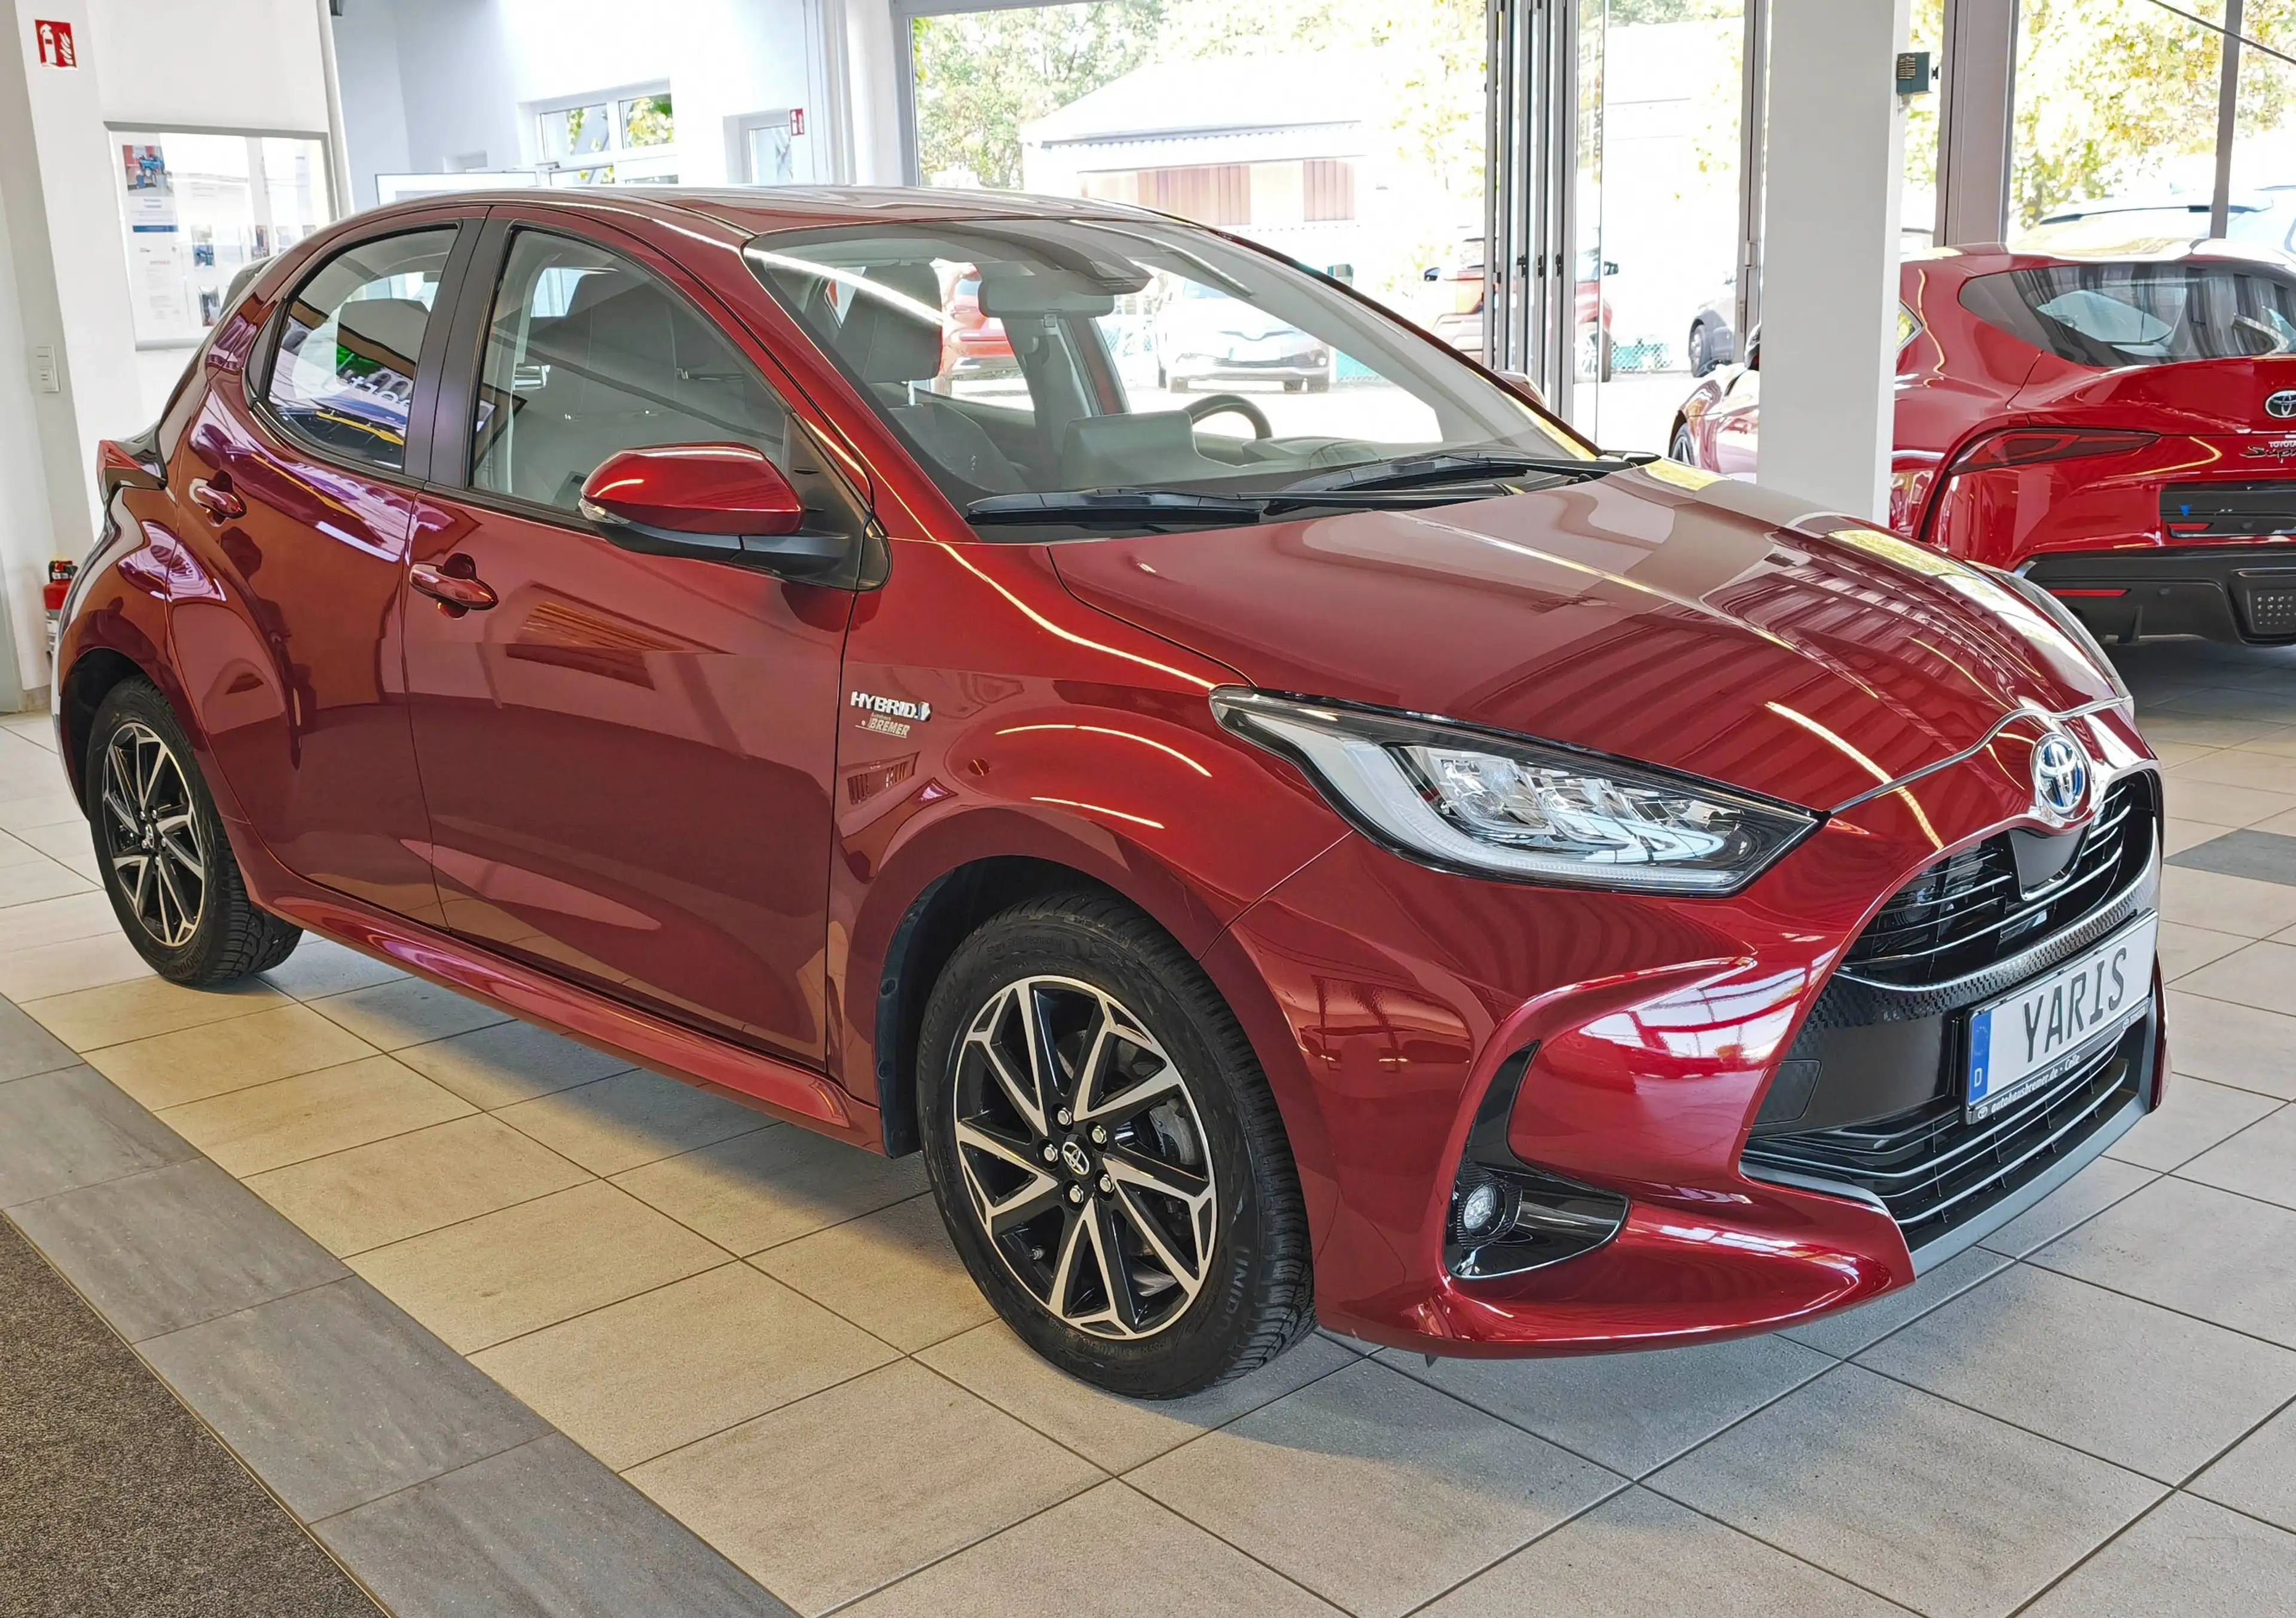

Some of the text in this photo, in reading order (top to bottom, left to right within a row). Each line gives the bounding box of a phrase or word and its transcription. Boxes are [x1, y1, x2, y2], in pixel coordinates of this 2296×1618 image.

[850, 691, 917, 719] HYBRID
[869, 718, 911, 736] BREMER
[2023, 945, 2127, 1063] YARIS
[1974, 1068, 1983, 1088] D
[1991, 1067, 2059, 1113] autohausbremer.de
